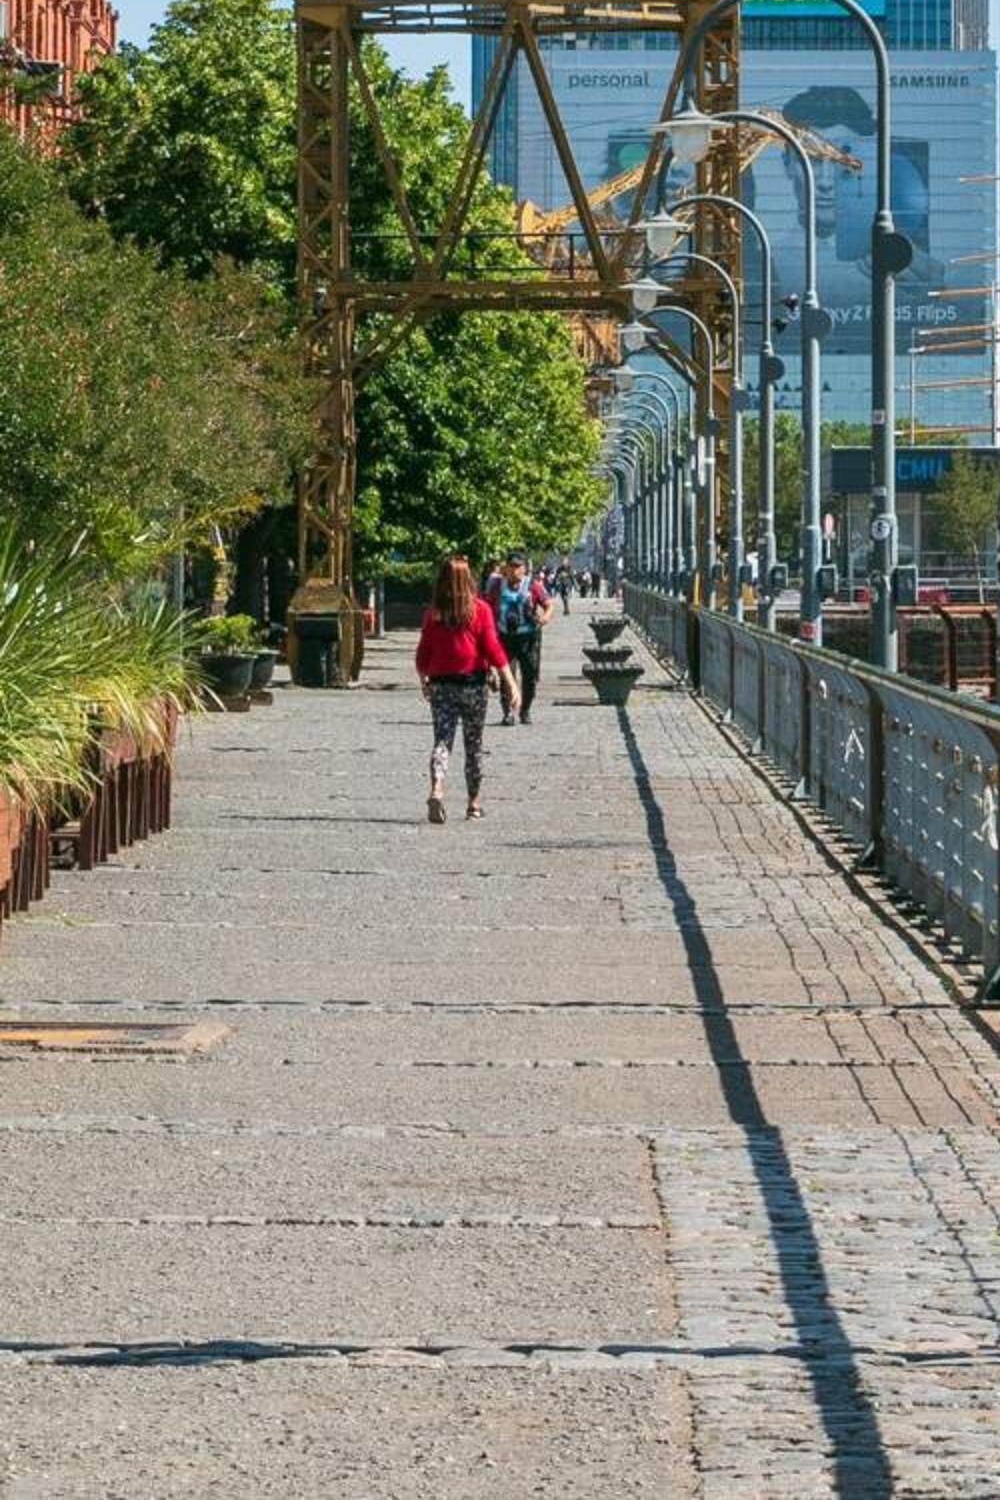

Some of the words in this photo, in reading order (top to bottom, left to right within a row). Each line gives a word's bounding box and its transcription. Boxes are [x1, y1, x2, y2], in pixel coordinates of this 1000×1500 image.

[568, 70, 650, 91] personal
[889, 75, 970, 88] SAMSUNG
[917, 305, 958, 324] Flip5
